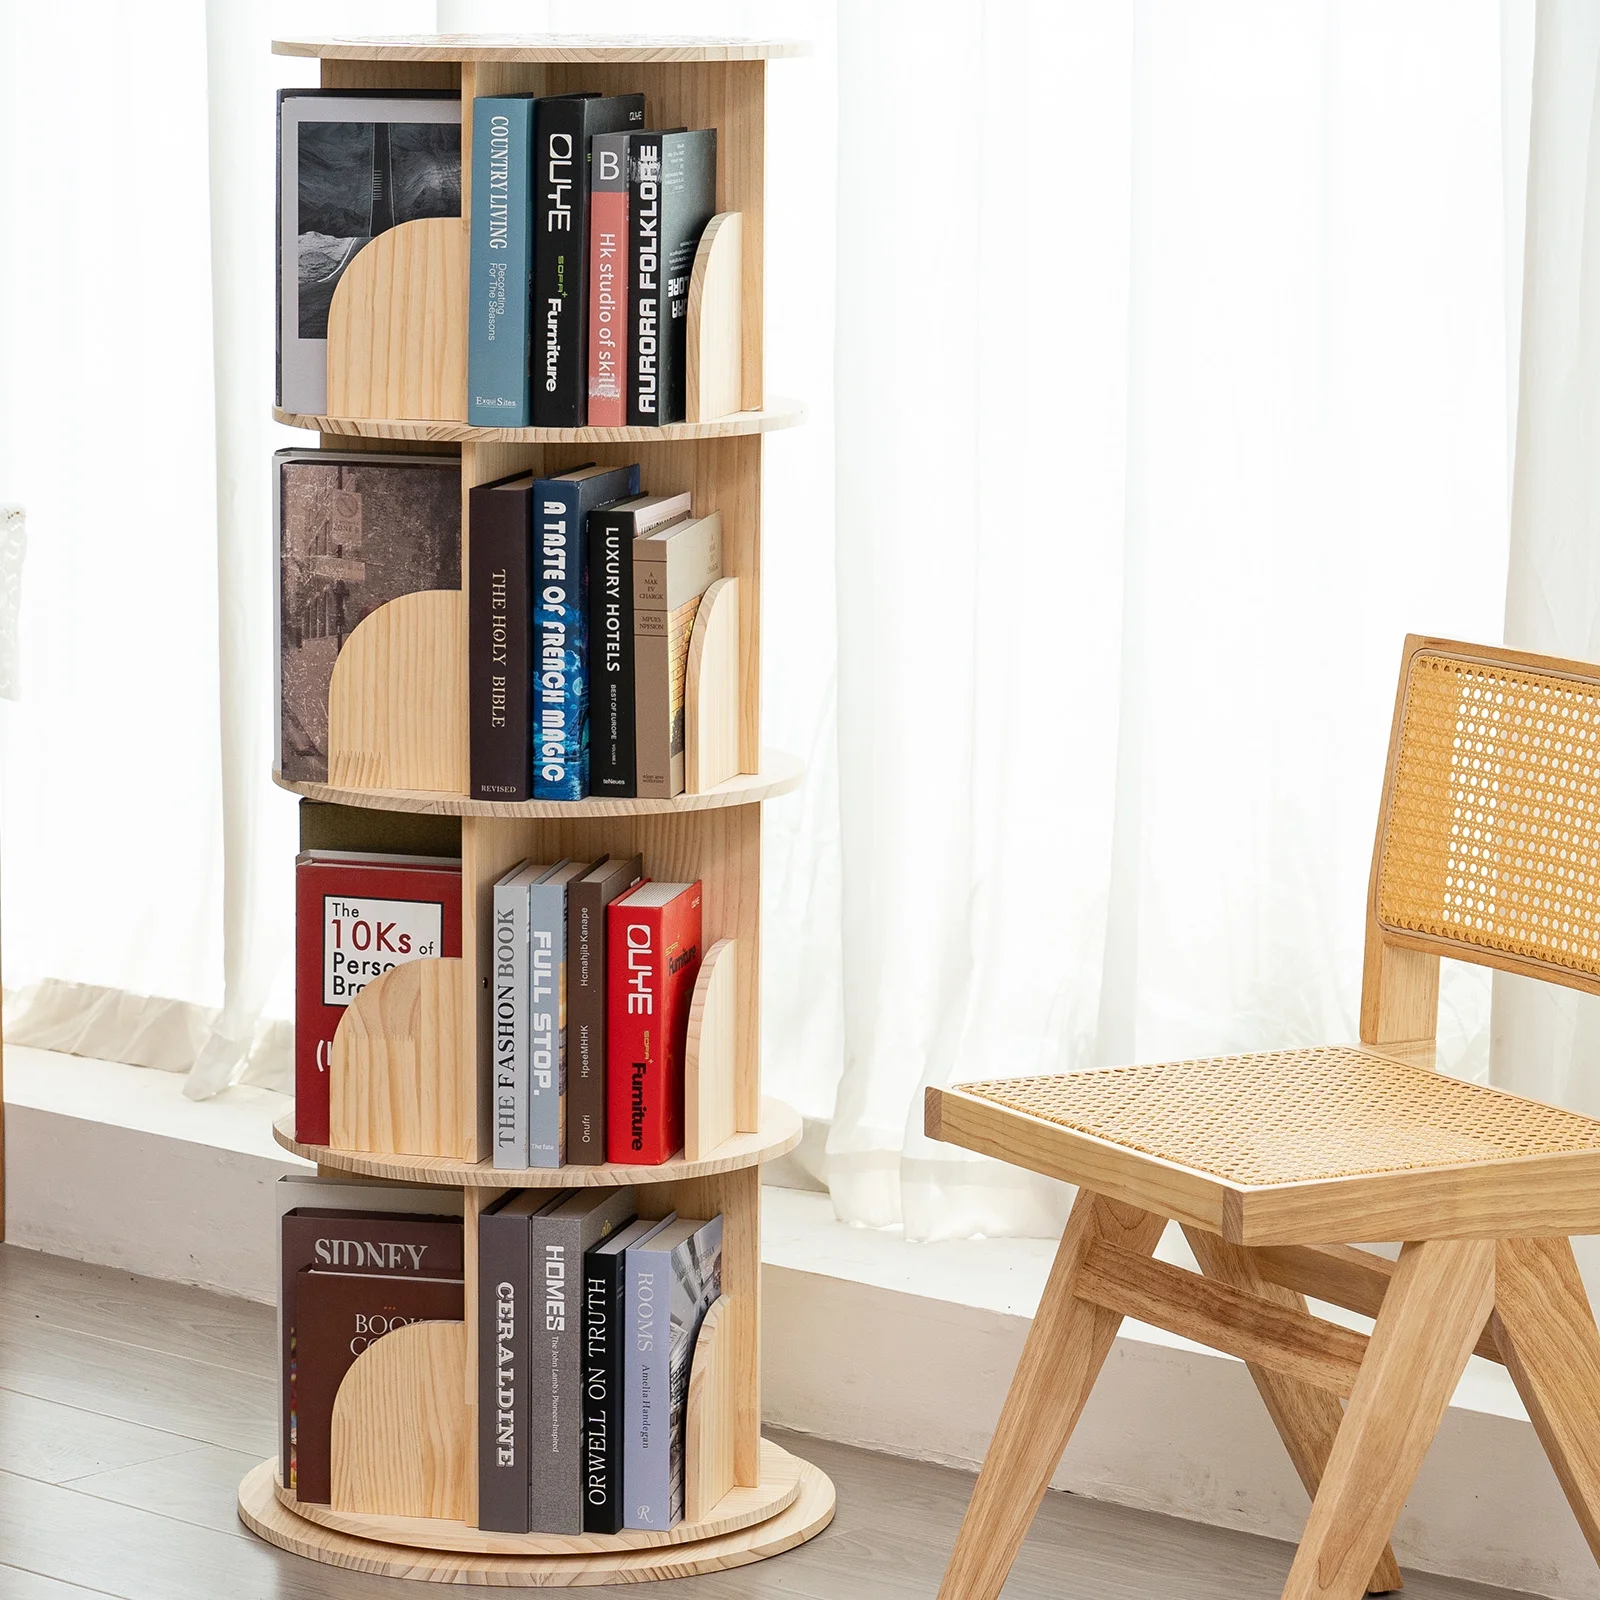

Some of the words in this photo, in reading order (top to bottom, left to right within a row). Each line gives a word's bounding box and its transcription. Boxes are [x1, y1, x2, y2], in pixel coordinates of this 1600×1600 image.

[489, 116, 509, 193] COUNTRY
[599, 151, 620, 180] B
[488, 193, 508, 249] LIVING
[638, 145, 657, 290] FOLKLORE
[489, 262, 498, 278] For
[599, 233, 615, 258] Hk
[489, 280, 498, 298] The
[496, 263, 507, 315] Decorating
[598, 263, 616, 322] studio
[488, 300, 497, 341] Seasons
[545, 298, 563, 392] Furniture
[599, 327, 616, 347] of
[597, 351, 616, 390] skill
[637, 298, 657, 413] AURORA
[543, 501, 567, 514] A
[542, 520, 567, 580] TASTE
[605, 527, 620, 599] LUXURY
[492, 569, 506, 609] THE
[542, 585, 566, 616] OF
[492, 615, 507, 666] HOLY
[541, 620, 566, 702] FRENCH
[605, 603, 620, 672] HOTELS
[491, 676, 506, 728] BIBLE
[610, 702, 617, 712] OF
[541, 709, 565, 782] MAGIC
[481, 785, 517, 793] REVISED
[332, 902, 360, 918] The
[579, 907, 590, 942] Kanape
[331, 919, 412, 954] 10Ks
[419, 941, 434, 955] of
[497, 908, 515, 979] BOOK
[533, 931, 552, 1003] FULL
[497, 984, 515, 1088] FASHON
[533, 1013, 552, 1095] STOP.
[498, 1095, 516, 1148] THE
[582, 1115, 591, 1143] Onufri
[631, 1062, 647, 1151] Furniture
[314, 1238, 428, 1270] SIDNEY
[545, 1244, 565, 1332] HOMES
[636, 1272, 654, 1352] ROOMS
[551, 1335, 559, 1349] The
[587, 1277, 606, 1358] TRUTH
[551, 1350, 559, 1368] John
[587, 1367, 606, 1400] ON
[641, 1364, 651, 1398] Amelia
[551, 1395, 560, 1453] Pioneer-Inspired
[640, 1400, 651, 1449] Handegan
[587, 1410, 606, 1506] ORWELL
